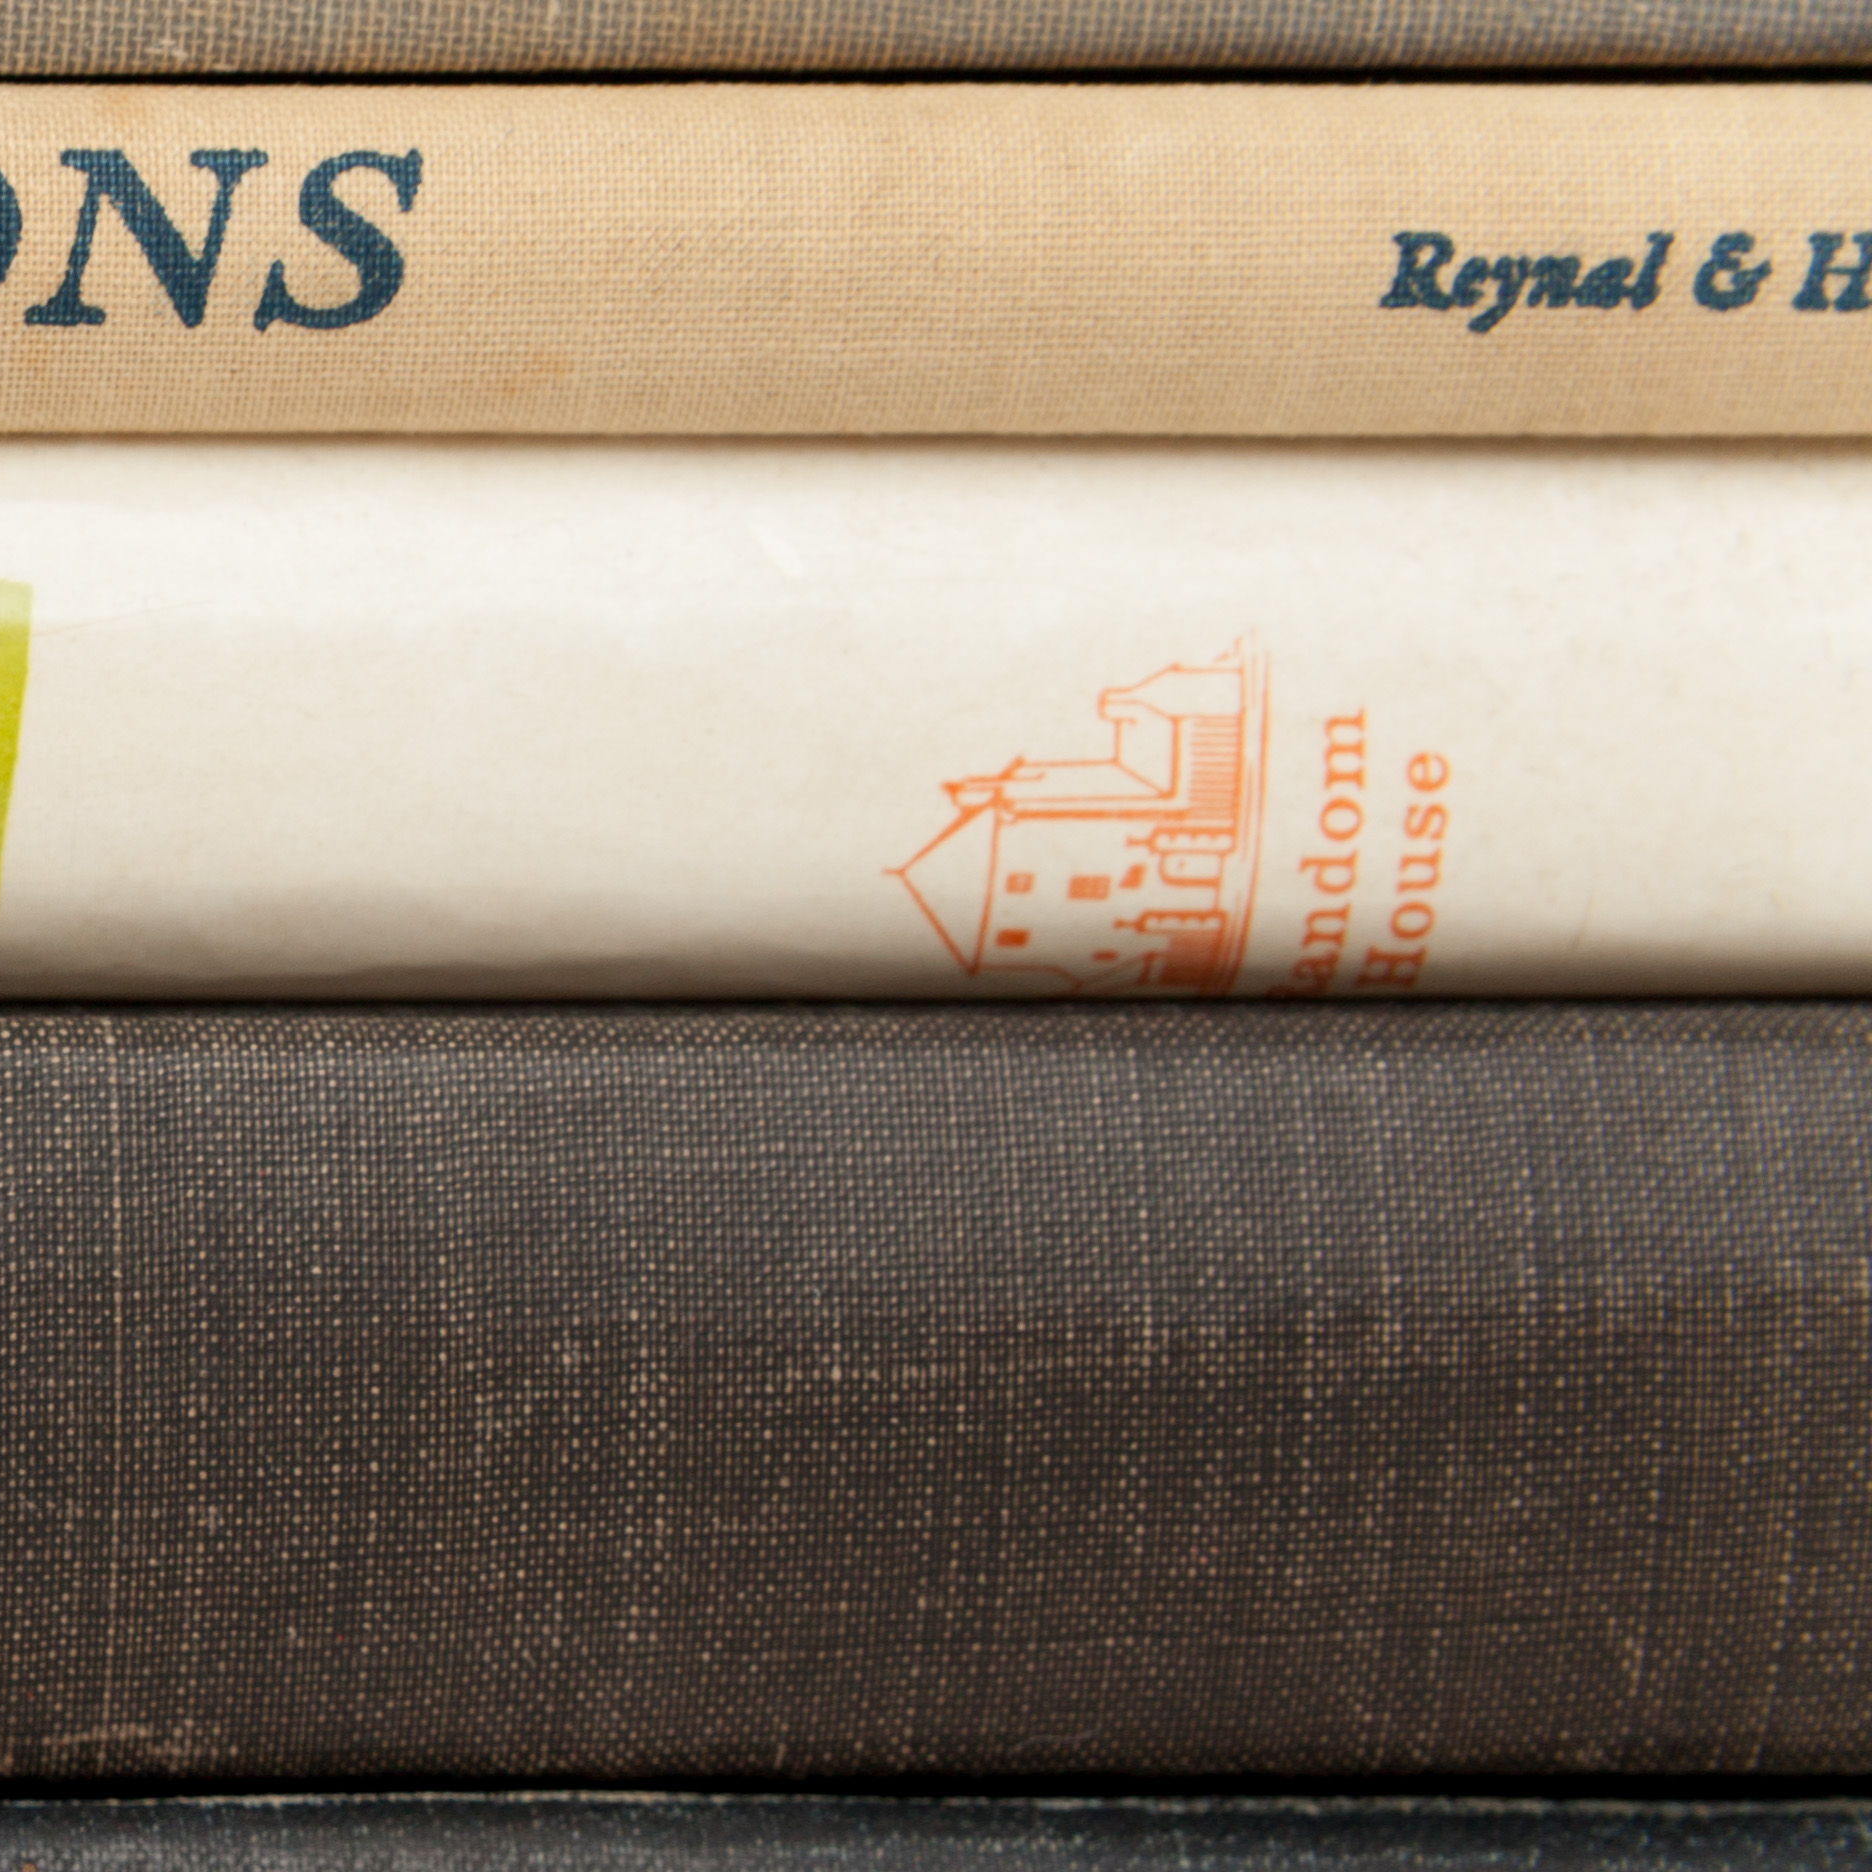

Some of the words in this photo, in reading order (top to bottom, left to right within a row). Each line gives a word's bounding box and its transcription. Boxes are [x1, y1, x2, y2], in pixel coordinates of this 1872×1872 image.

[1378, 230, 1675, 333] Reynal
[1692, 231, 1773, 312] &
[1262, 706, 1368, 1001] andom
[1355, 750, 1451, 990] House
